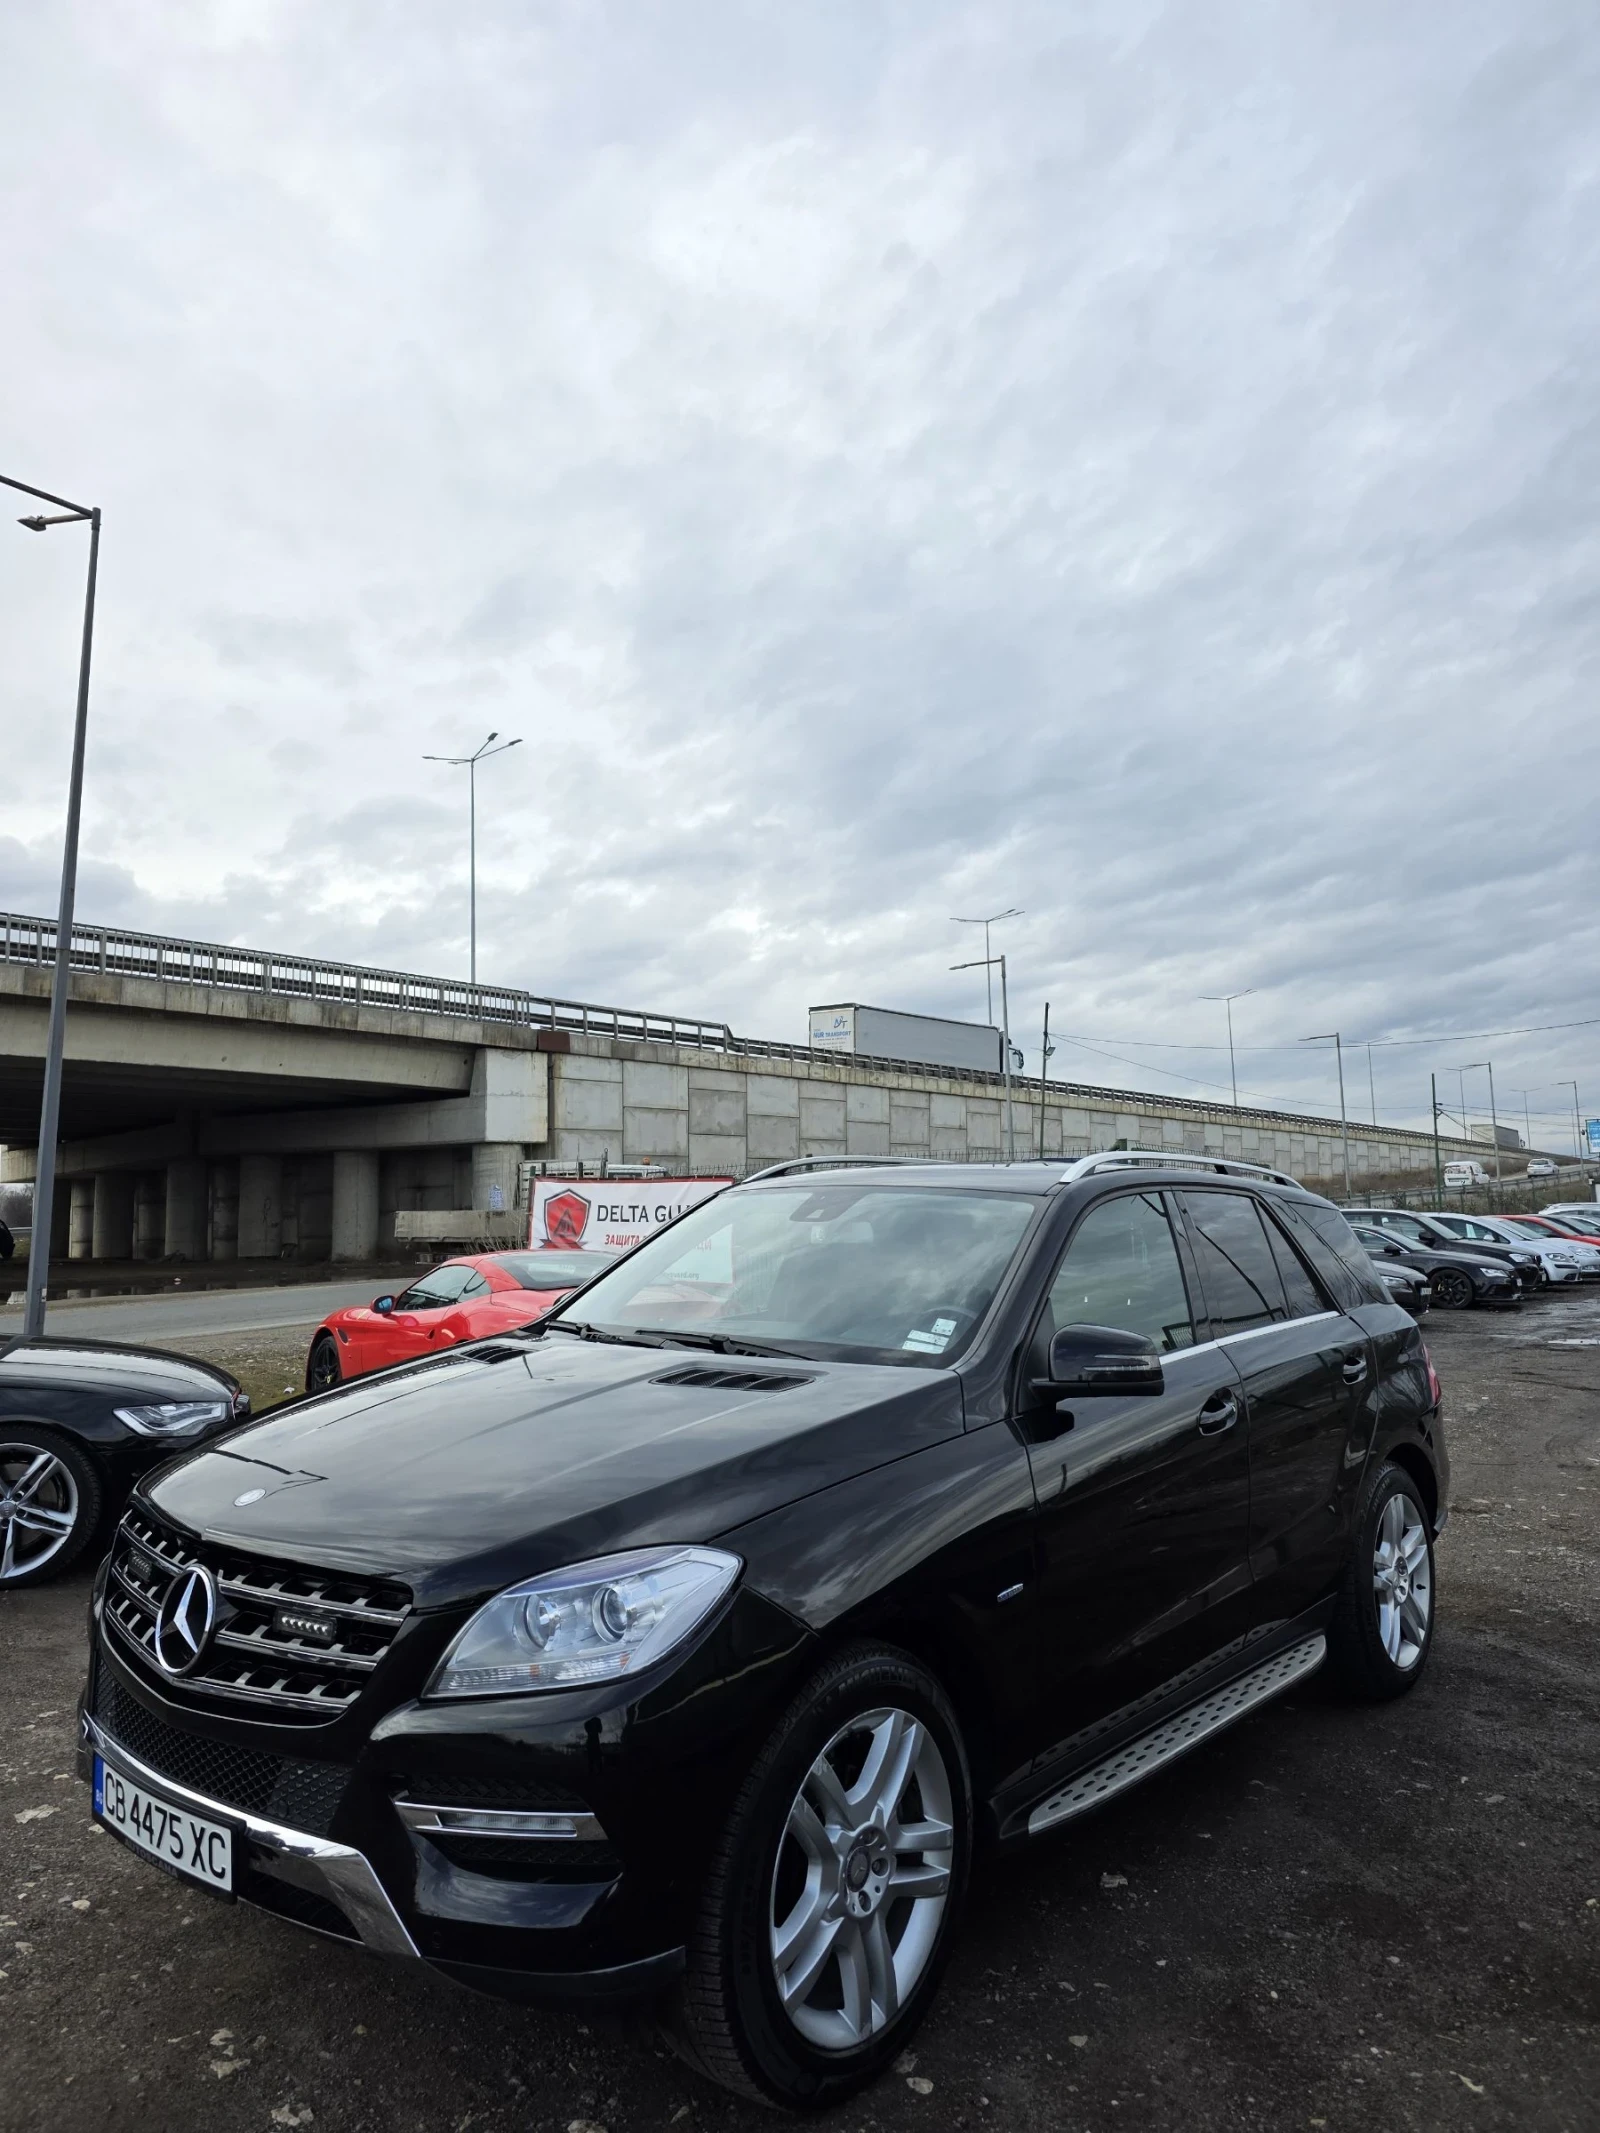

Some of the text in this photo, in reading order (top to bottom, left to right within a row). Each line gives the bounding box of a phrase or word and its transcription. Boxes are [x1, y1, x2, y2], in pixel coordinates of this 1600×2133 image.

[825, 1030, 851, 1038] TRANSPORT
[597, 1204, 691, 1223] DELTA GU
